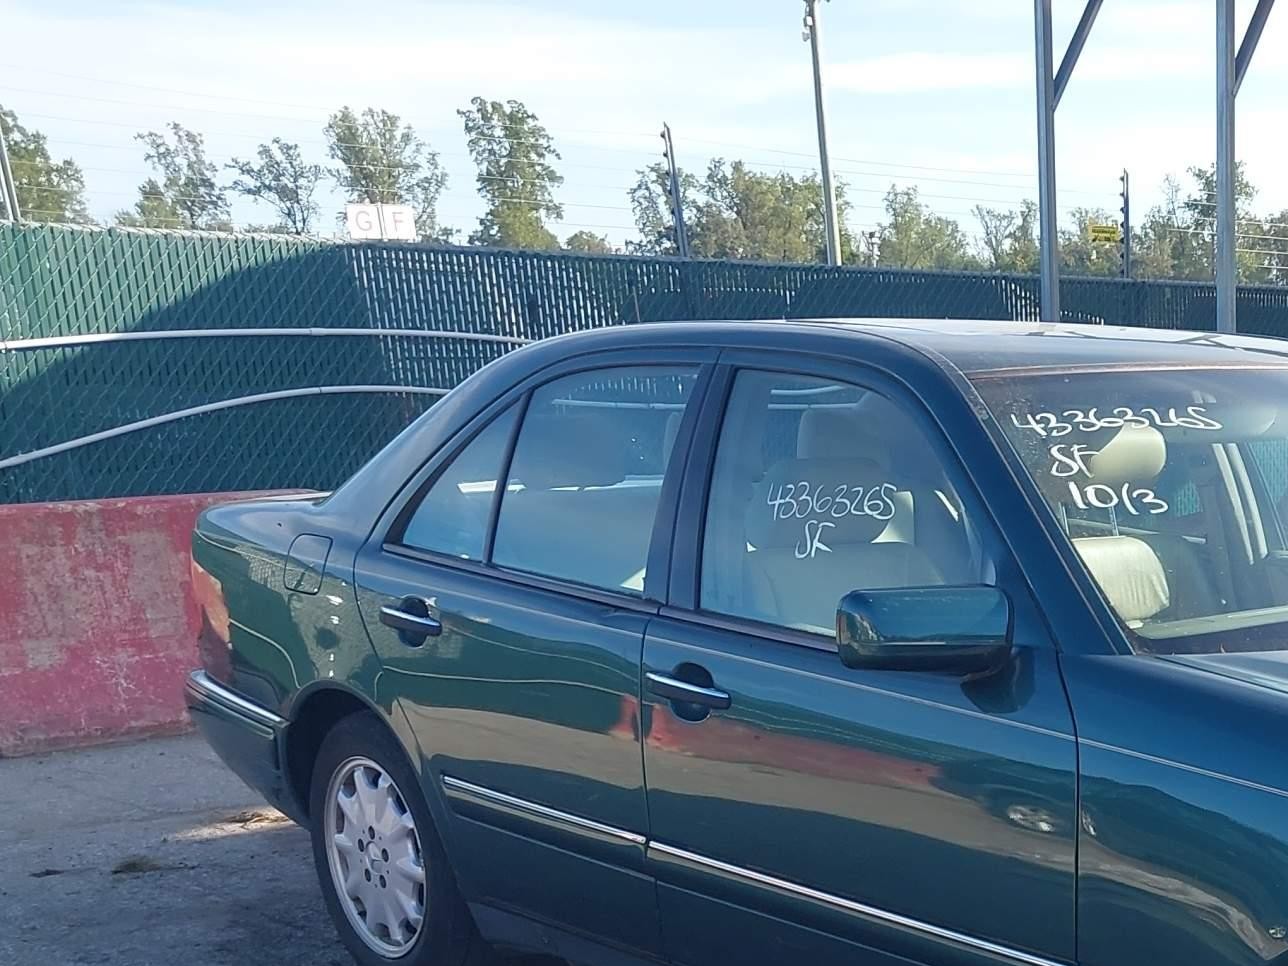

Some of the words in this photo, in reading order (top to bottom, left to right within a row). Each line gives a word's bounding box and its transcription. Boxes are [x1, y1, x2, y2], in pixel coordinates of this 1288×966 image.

[355, 211, 372, 231] G
[391, 212, 404, 232] F
[767, 481, 897, 520] 43363265
